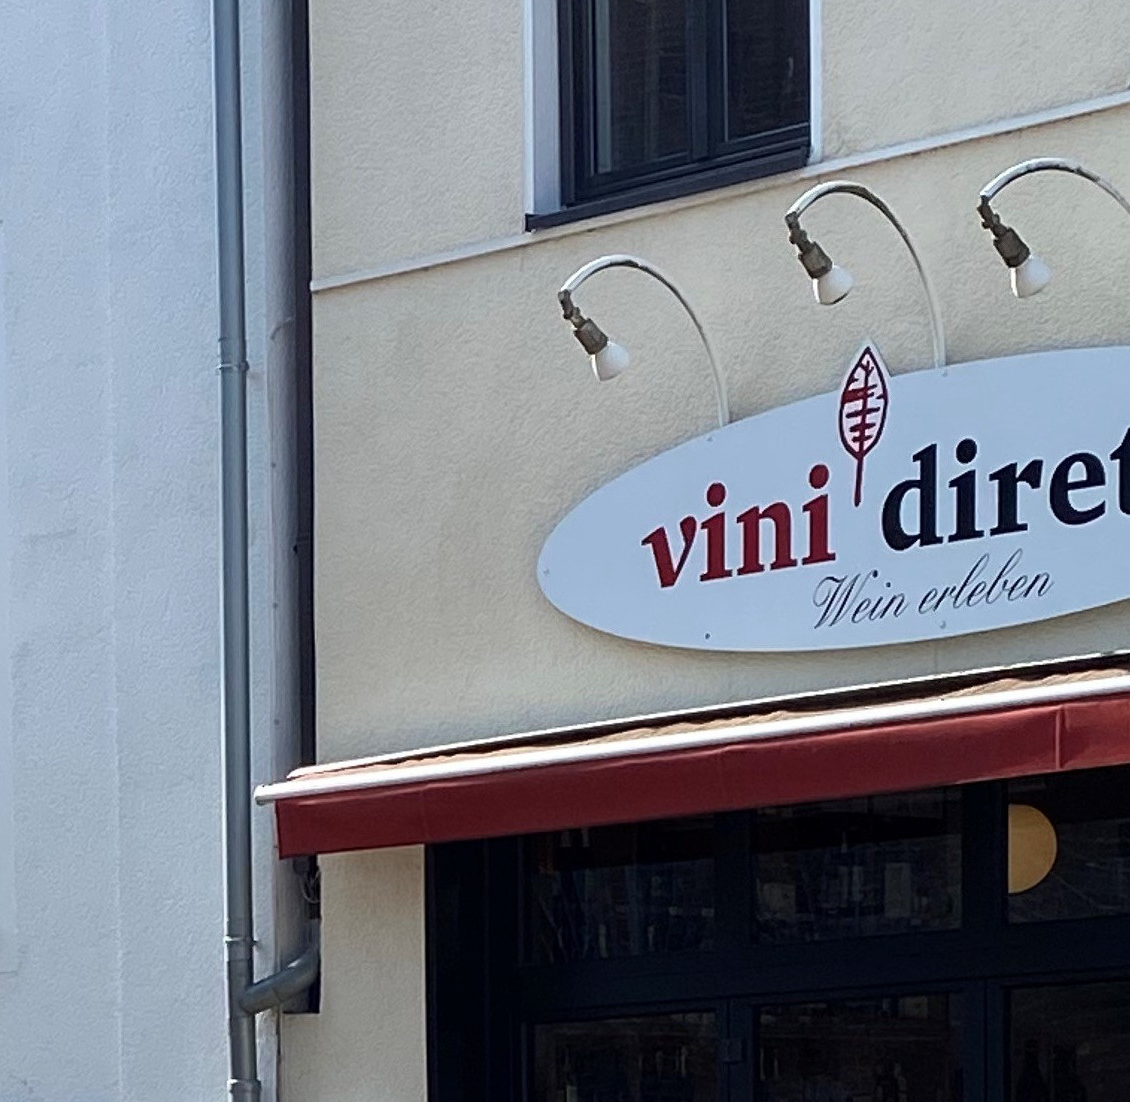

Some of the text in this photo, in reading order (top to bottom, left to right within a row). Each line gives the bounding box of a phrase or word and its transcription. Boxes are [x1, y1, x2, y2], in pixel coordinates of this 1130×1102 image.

[642, 463, 836, 588] vini
[813, 548, 1054, 629] Wein erleben
